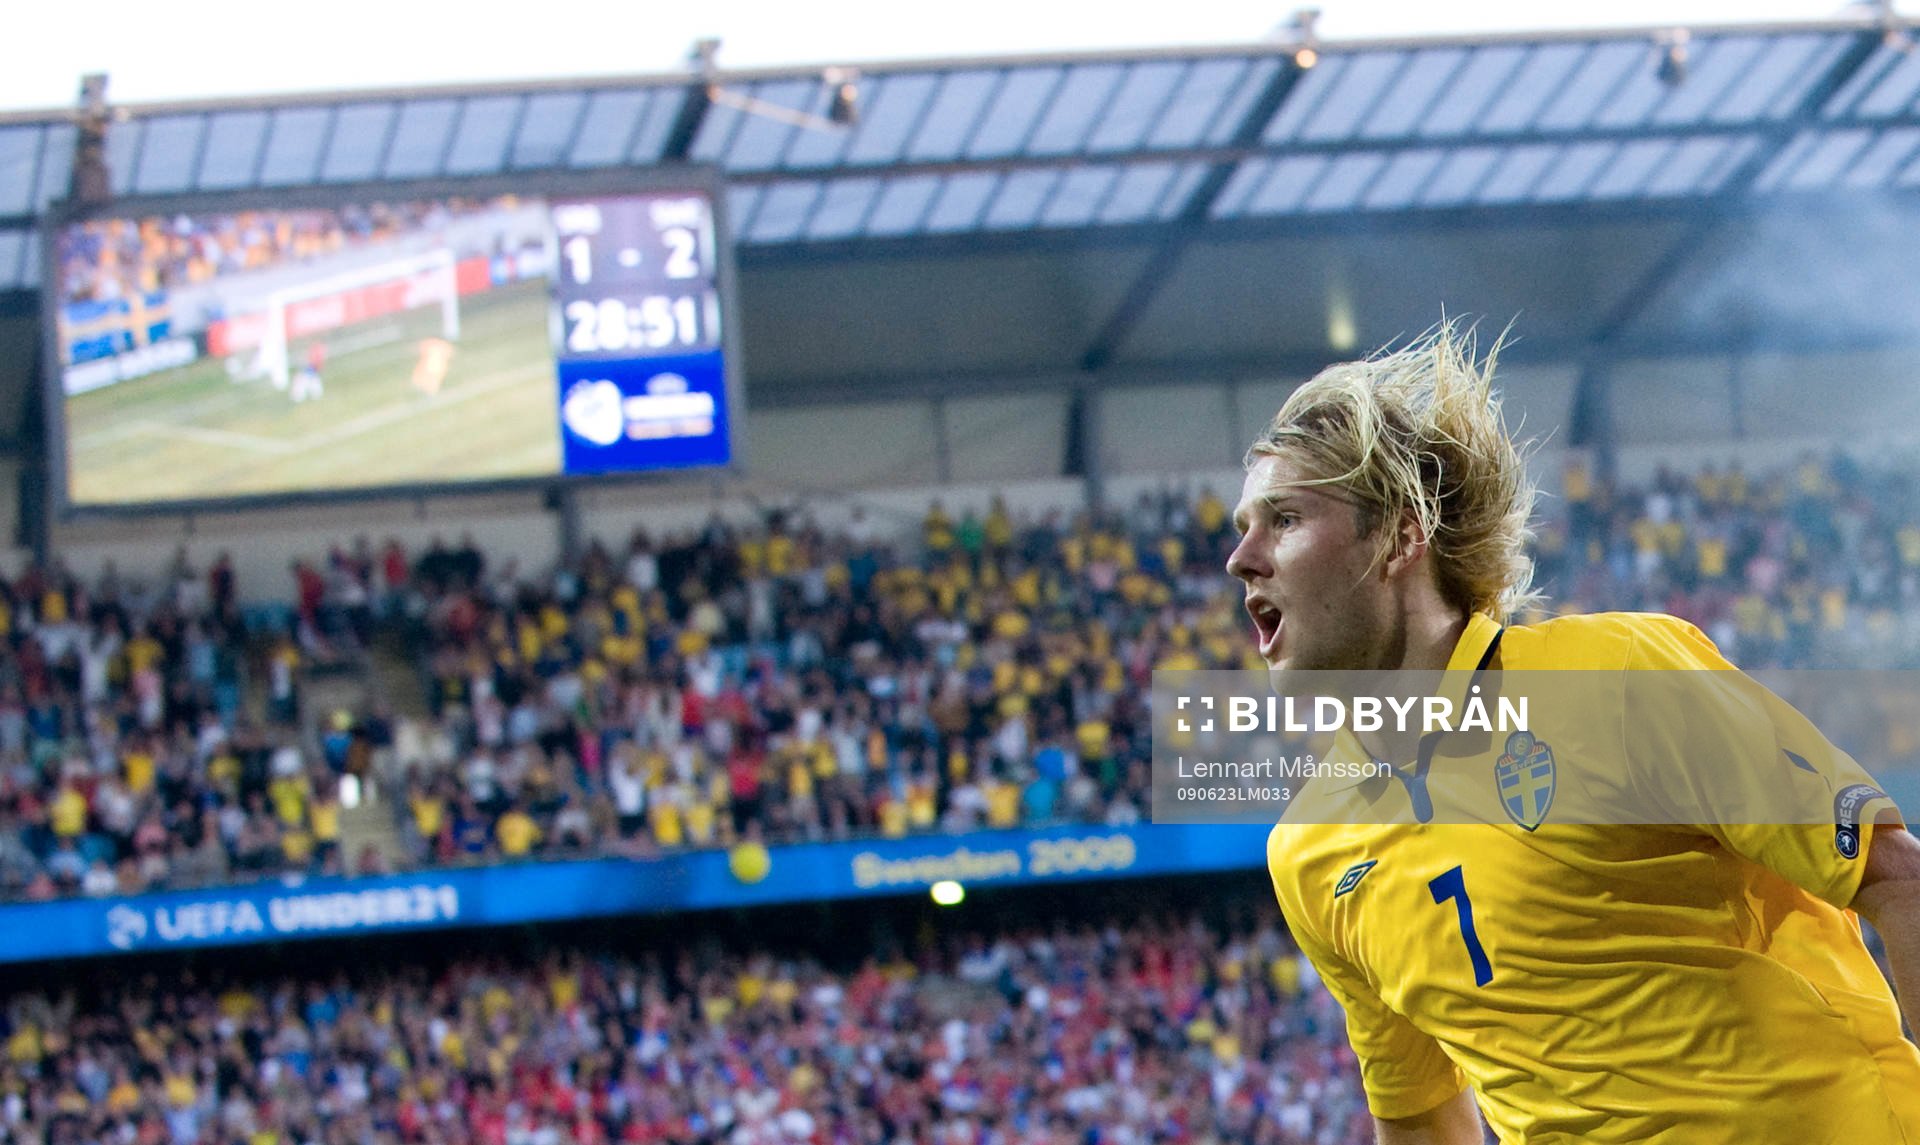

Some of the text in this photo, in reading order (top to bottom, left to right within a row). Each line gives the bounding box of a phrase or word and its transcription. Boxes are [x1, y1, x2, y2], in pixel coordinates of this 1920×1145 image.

[563, 235, 592, 285] 1
[660, 227, 700, 280] 2
[852, 834, 1136, 888] Sweden 2009
[155, 900, 263, 941] UEFA
[1428, 864, 1494, 988] 7
